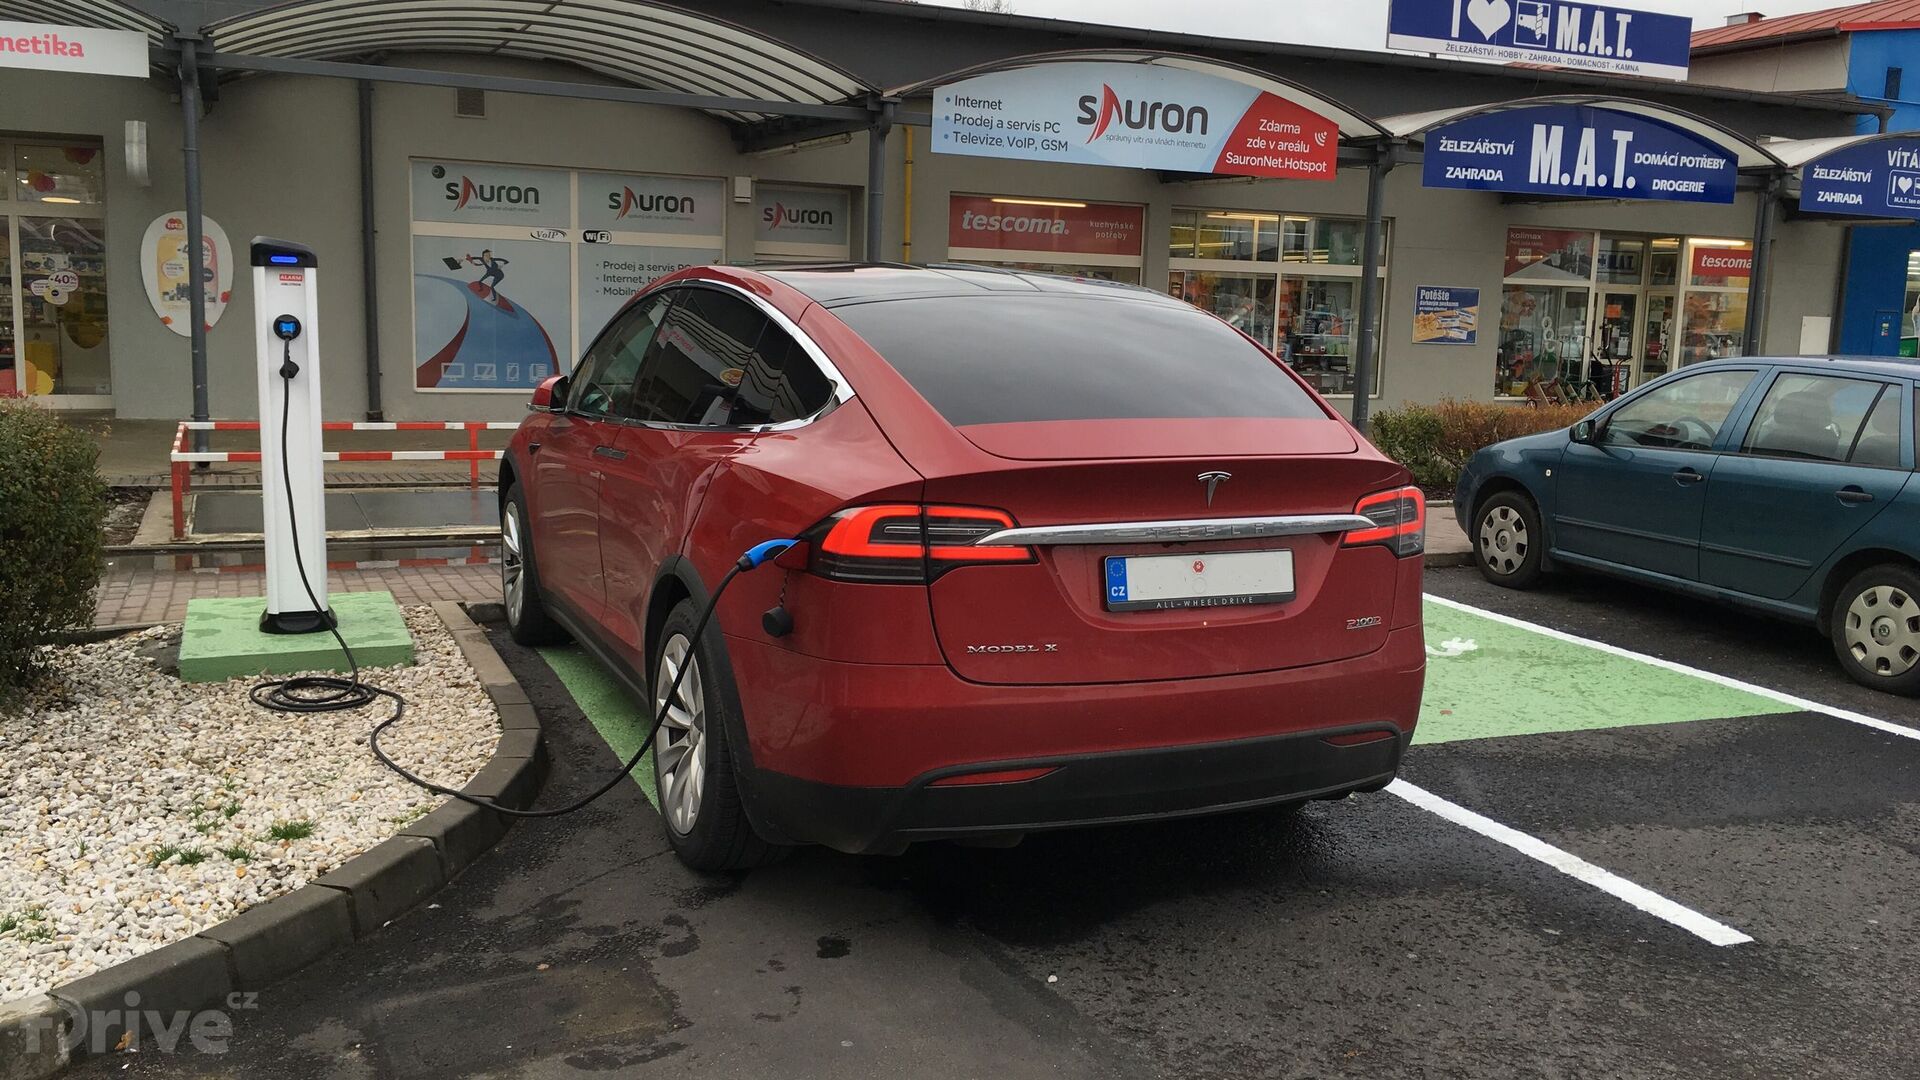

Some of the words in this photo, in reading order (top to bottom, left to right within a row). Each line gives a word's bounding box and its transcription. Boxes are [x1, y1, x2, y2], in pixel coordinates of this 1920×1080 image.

[1555, 5, 1633, 58] M.A.T.
[1498, 50, 1524, 59] HOBBY
[1528, 53, 1562, 64] ZAHRADA
[1615, 63, 1640, 72] KAMNA
[954, 95, 1003, 110] Internet
[953, 113, 994, 129] Prodej
[996, 120, 1004, 129] a
[1006, 119, 1041, 132] servis
[1043, 121, 1061, 133] PC
[1259, 119, 1301, 134] Zdarma
[1006, 135, 1038, 151] VoIP,
[1040, 139, 1068, 152] GSM
[1176, 138, 1207, 149] internetu
[1246, 138, 1267, 149] zde
[1268, 141, 1276, 150] v
[1277, 139, 1310, 153] areálu
[1439, 136, 1515, 156] ŽELEZÁŘSTVÍ
[1226, 152, 1328, 173] SauronNet.Hotspot
[1529, 123, 1636, 189] M.A.T.
[1634, 151, 1679, 167] DOMÁCÍ
[1680, 154, 1726, 170] POTŘEBY
[1887, 147, 1920, 169] VÍTÁ
[1445, 166, 1504, 182] ZAHRADA
[1812, 164, 1872, 183] ŽELEZÁŘSTVÍ
[1651, 179, 1705, 193] DROGERIE
[1817, 191, 1863, 205] ZAHRADA
[536, 230, 559, 240] VoIP
[603, 261, 636, 272] Prodej
[646, 263, 675, 272] servis
[603, 274, 645, 285] Internet,
[603, 287, 640, 296] Mobiln
[1420, 289, 1450, 301] Potěšte
[1111, 586, 1126, 597] CZ
[1222, 596, 1254, 606] DRIVE
[1044, 643, 1059, 652] X
